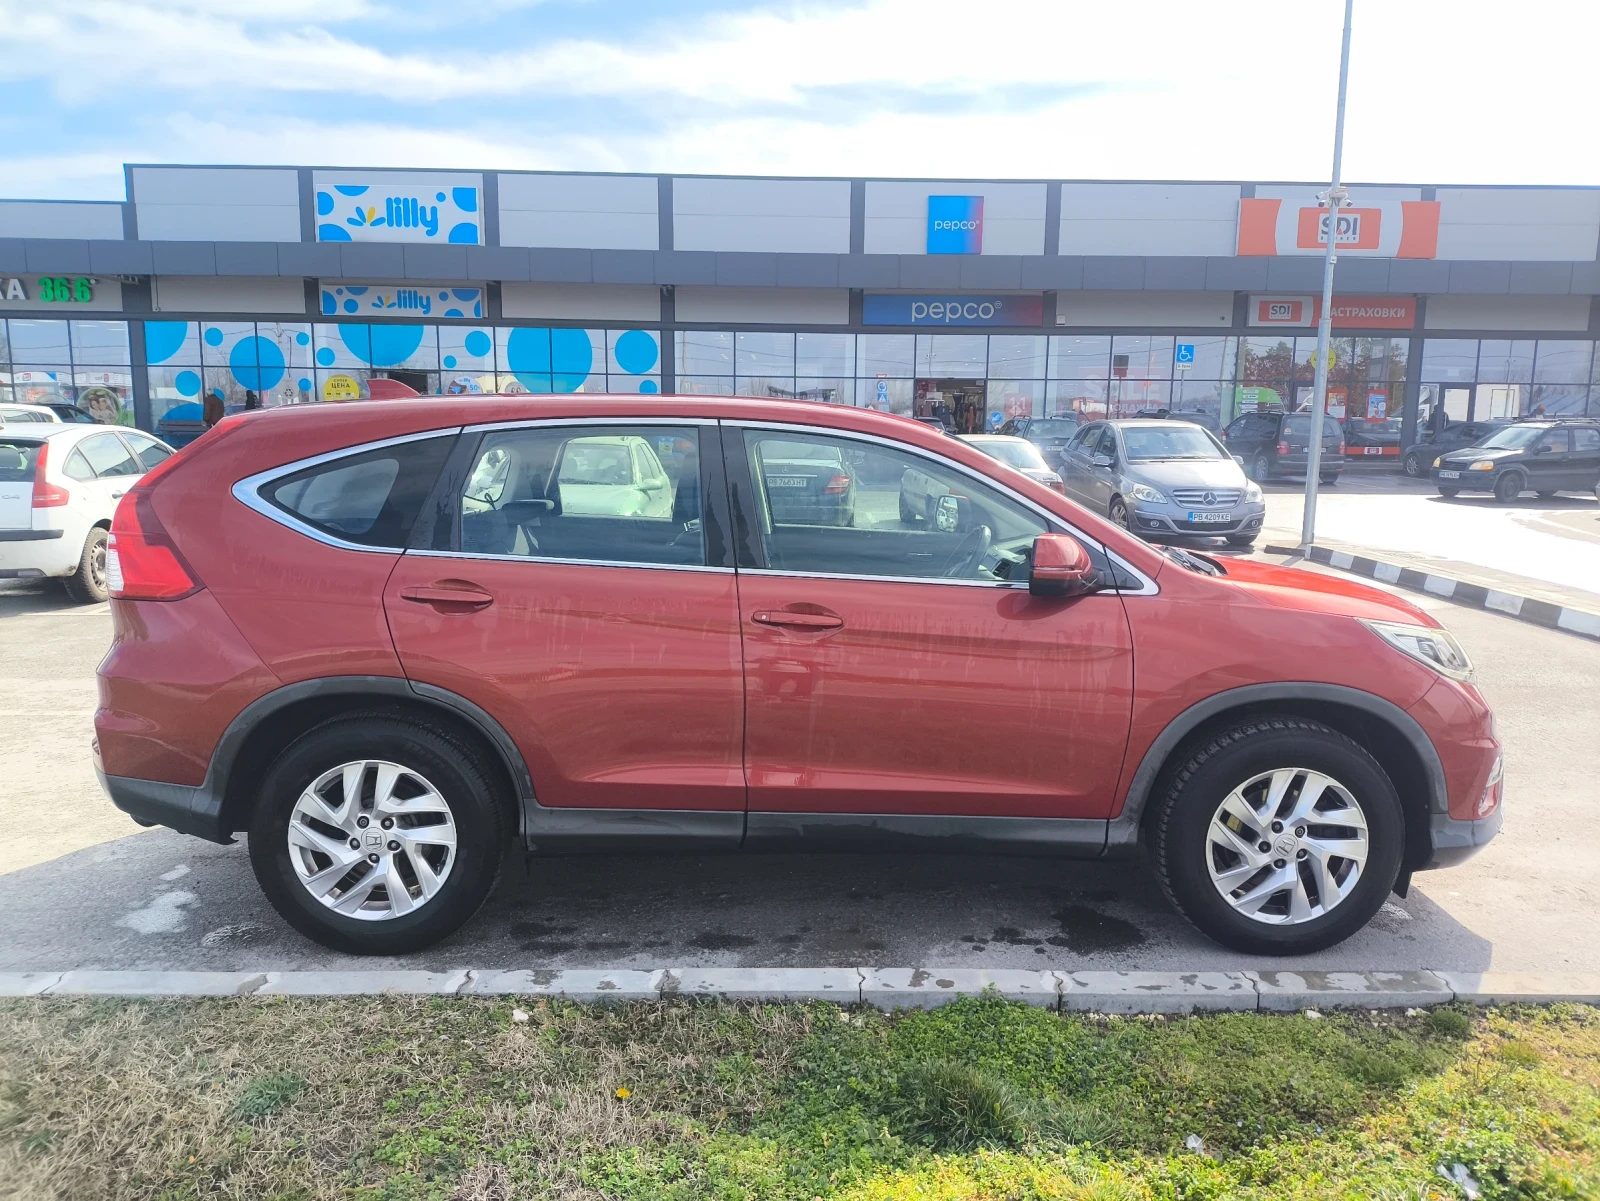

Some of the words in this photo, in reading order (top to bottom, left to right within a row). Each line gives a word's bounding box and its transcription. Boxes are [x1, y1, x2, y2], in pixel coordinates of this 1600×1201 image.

[386, 197, 439, 237] lilly
[396, 289, 431, 315] lilly
[1270, 305, 1291, 315] SDI
[1331, 307, 1406, 318] АСТРАХОВКИ
